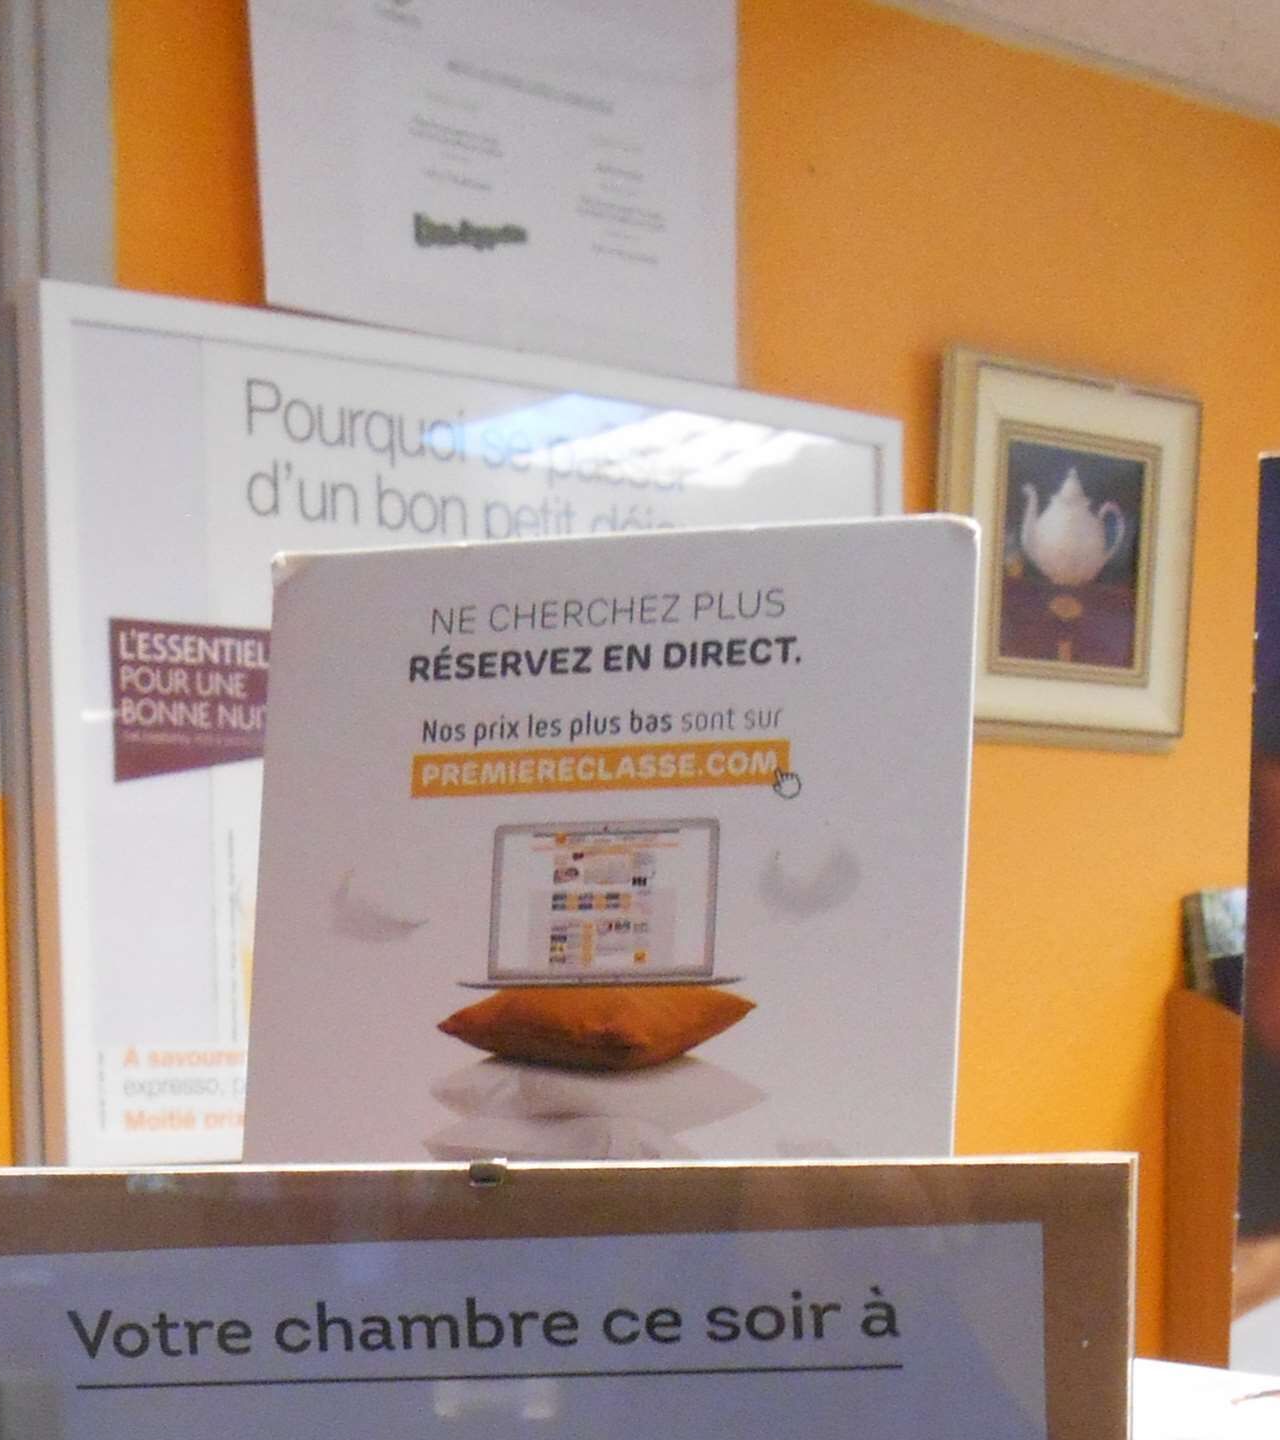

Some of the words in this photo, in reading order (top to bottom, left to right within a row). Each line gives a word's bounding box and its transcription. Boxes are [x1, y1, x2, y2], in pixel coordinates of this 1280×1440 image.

[245, 377, 466, 468] Pourquoi
[246, 460, 360, 526] d'un
[376, 474, 468, 535] bon
[484, 492, 575, 539] petit
[431, 606, 476, 636] NE
[489, 594, 680, 632] CHERCHEZ
[694, 588, 786, 620] PLUS
[119, 628, 270, 670] L'ESSENTIEL
[409, 645, 591, 683] RÉSERVEZ
[604, 643, 652, 672] EN
[664, 636, 801, 670] DIRECT.
[120, 664, 189, 695] POUR
[195, 669, 247, 700] UNE
[121, 695, 210, 729] BONNE
[422, 719, 466, 744] Nos
[473, 714, 519, 747] prix
[527, 714, 562, 738] les
[569, 710, 621, 742] plus
[629, 709, 673, 734] bas
[681, 707, 735, 732] sont
[744, 708, 784, 729] sur
[422, 750, 778, 787] PREMIERECLASSE.COM
[68, 1310, 252, 1359] Votre
[274, 1300, 579, 1354] chambre
[603, 1303, 683, 1346] ce
[705, 1290, 841, 1342] soir
[860, 1285, 900, 1338] à
